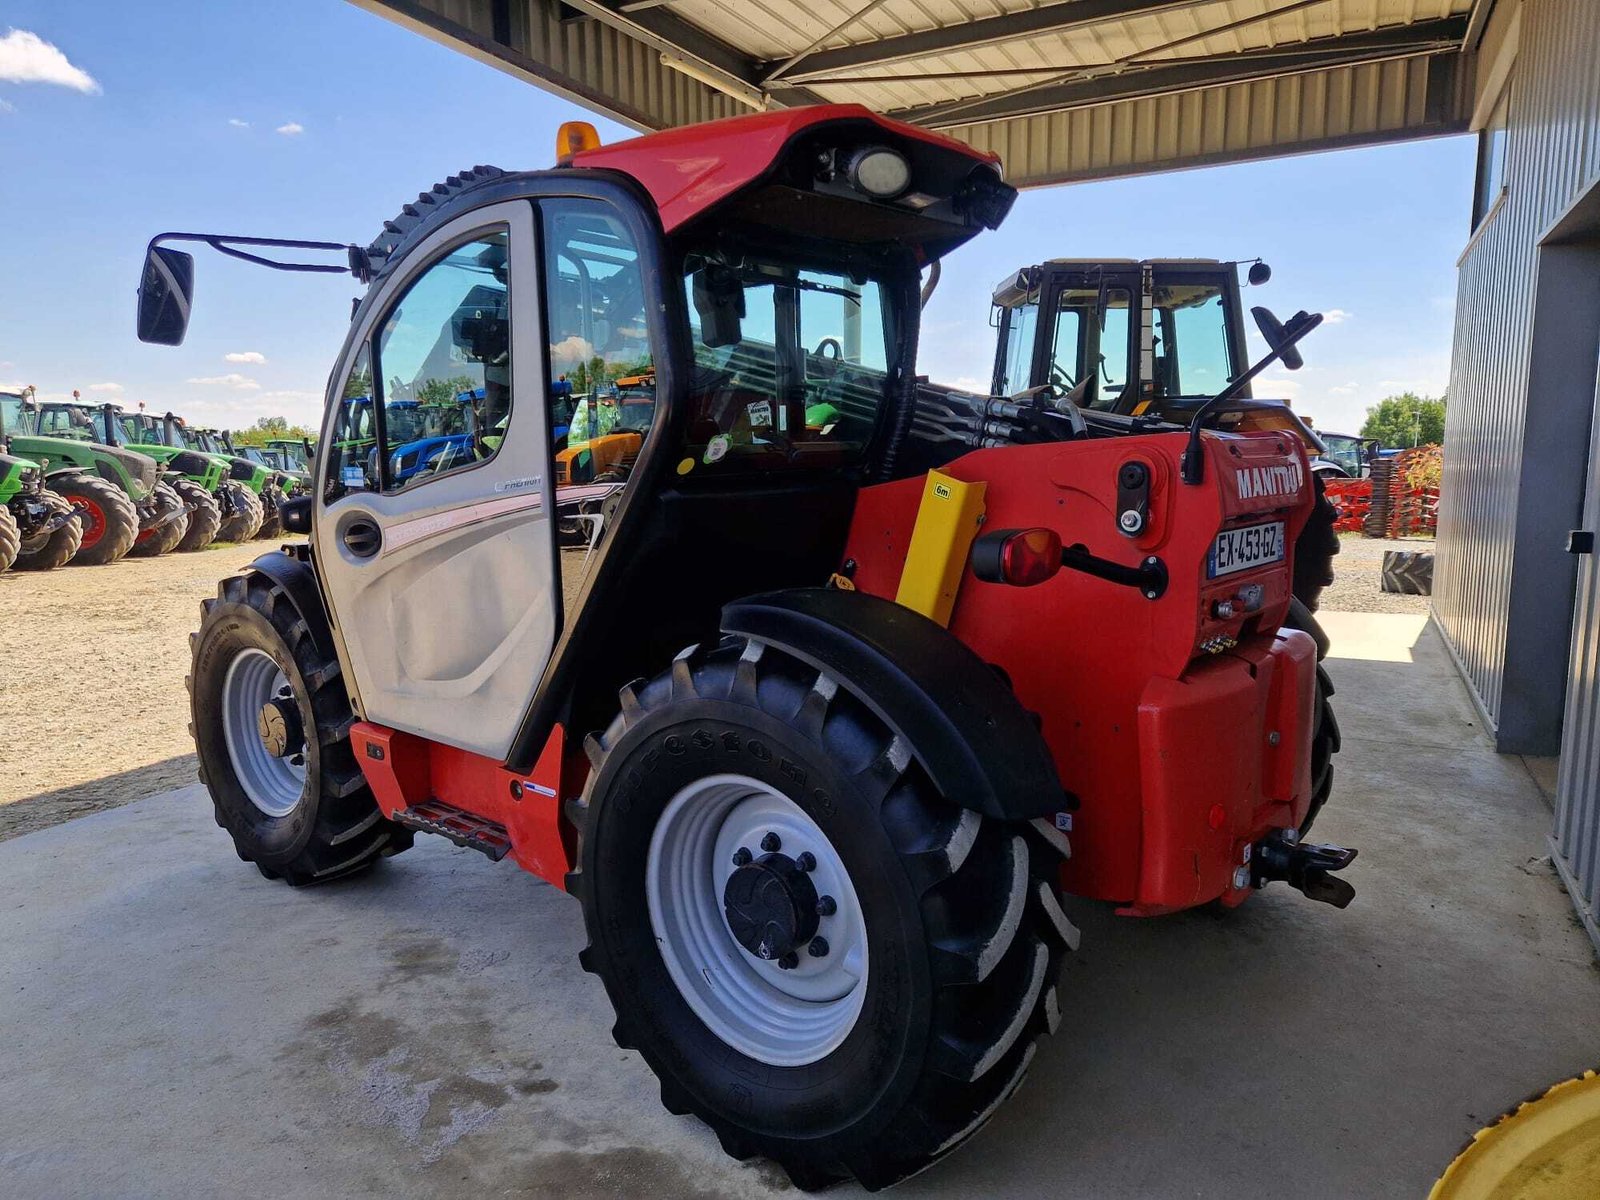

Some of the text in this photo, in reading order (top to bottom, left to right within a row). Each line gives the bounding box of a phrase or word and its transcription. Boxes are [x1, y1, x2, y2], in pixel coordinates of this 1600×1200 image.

[936, 485, 949, 497] 6m
[1236, 464, 1300, 499] MANITOU
[1218, 526, 1277, 569] EX-453-GZ
